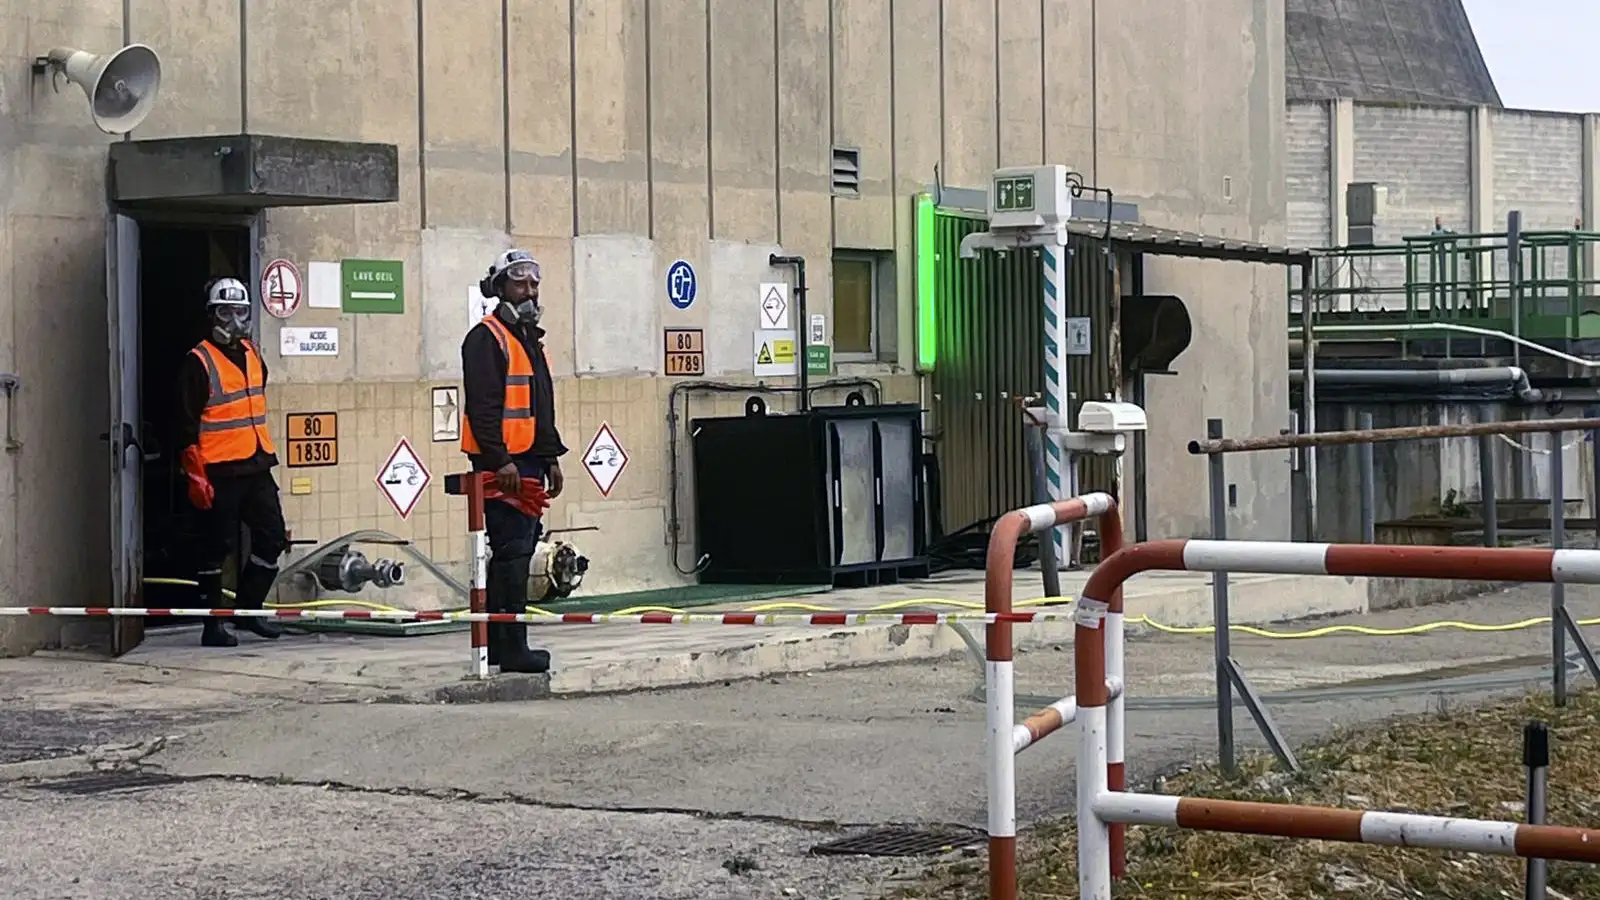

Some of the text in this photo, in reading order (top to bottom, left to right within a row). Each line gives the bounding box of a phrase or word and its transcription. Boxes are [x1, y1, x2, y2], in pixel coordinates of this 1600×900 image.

[353, 271, 394, 281] LAVE OEIL
[310, 331, 328, 340] ACIDE
[677, 333, 692, 350] 80
[671, 355, 699, 371] 1789
[304, 417, 321, 436] 80
[296, 443, 330, 462] 1830
